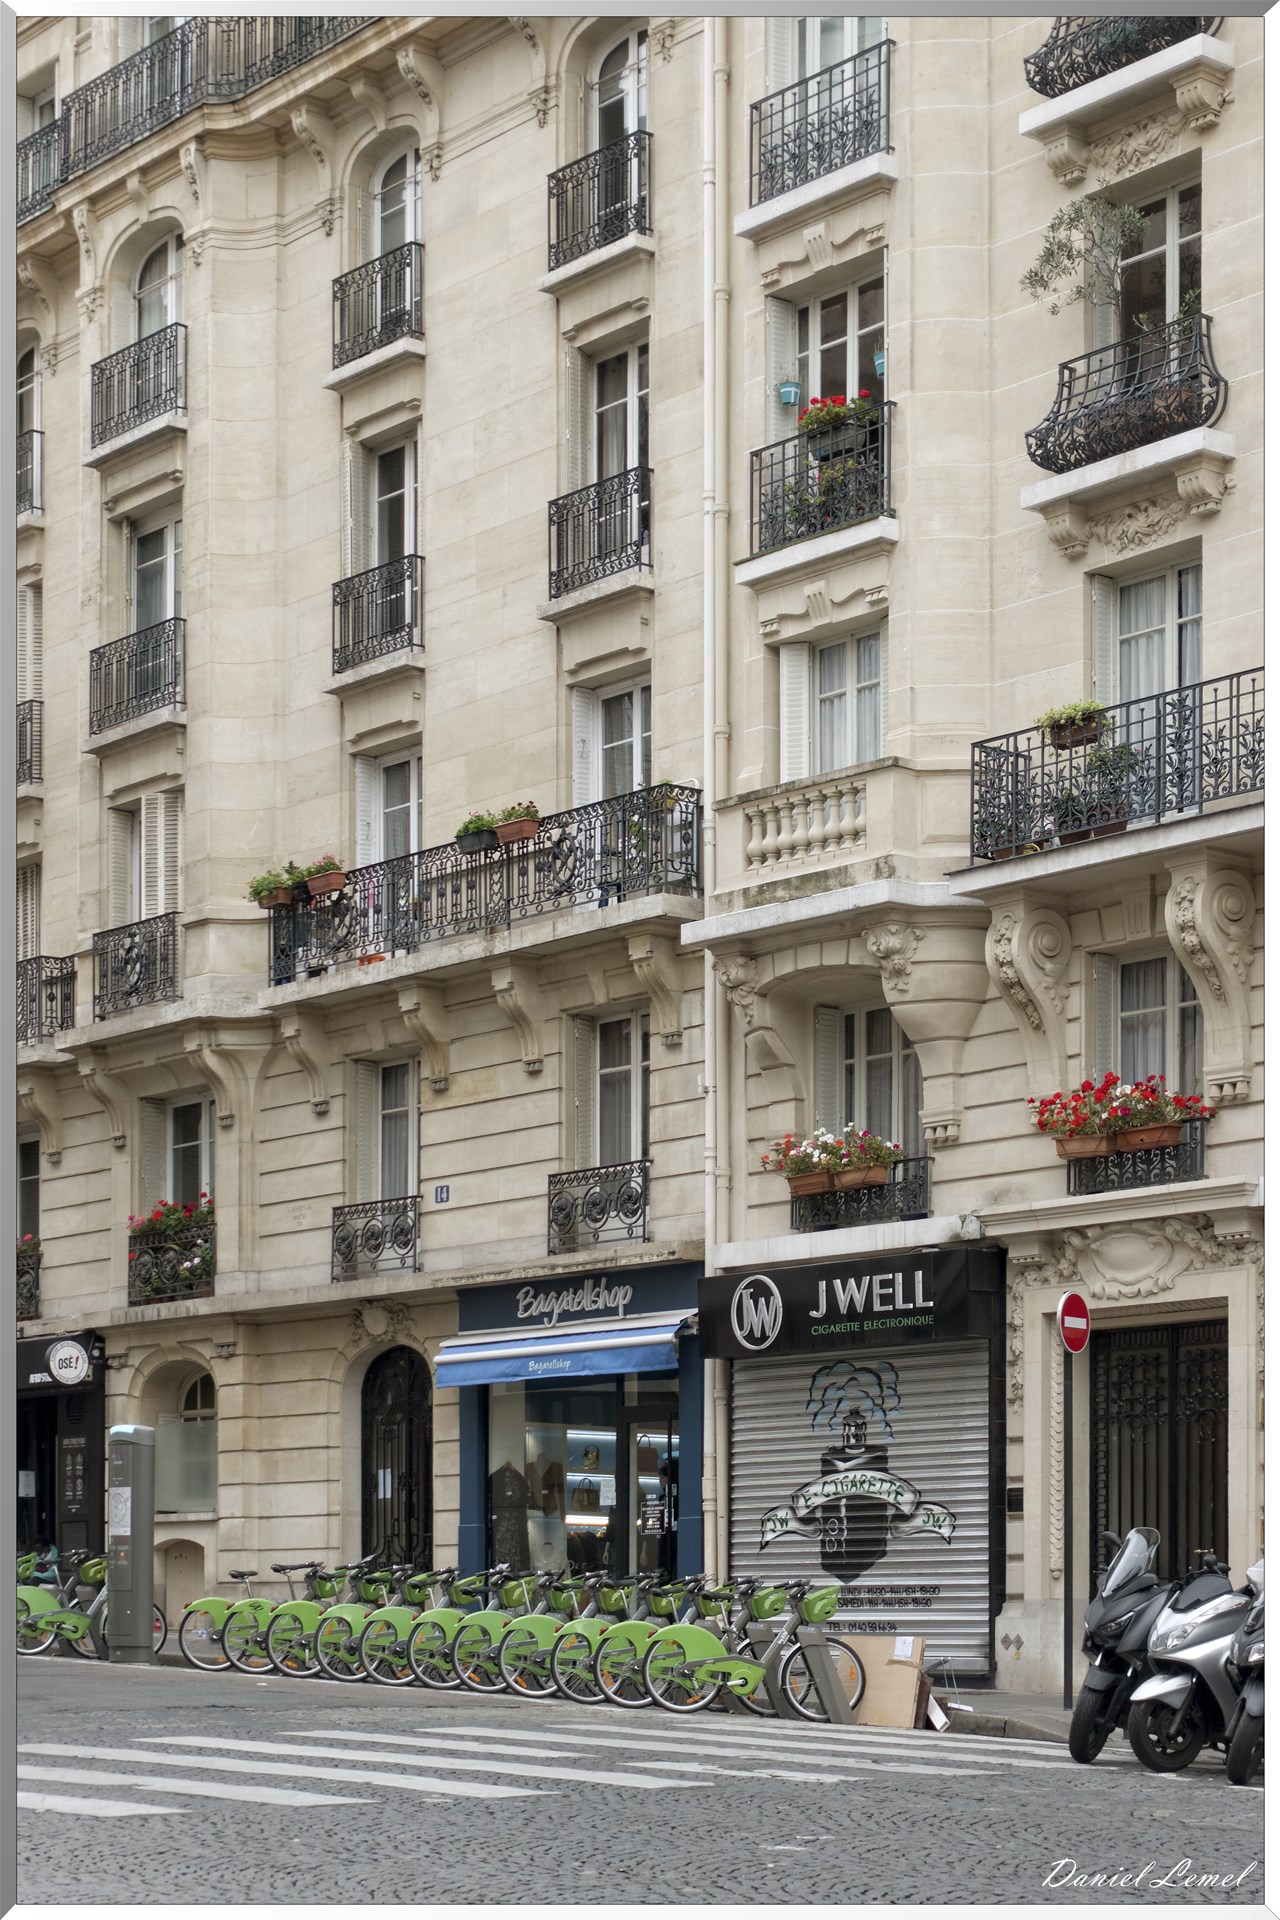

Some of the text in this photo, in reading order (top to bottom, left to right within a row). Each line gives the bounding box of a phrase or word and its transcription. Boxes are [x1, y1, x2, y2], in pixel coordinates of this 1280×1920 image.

[437, 1187, 448, 1201] 14
[516, 1277, 633, 1327] Bagatellshop
[811, 1315, 934, 1335] CIGARETTE ELECTRONIQUE
[528, 1359, 571, 1374] Bagatellshop
[768, 1512, 789, 1532] JW
[922, 1507, 947, 1530] JW
